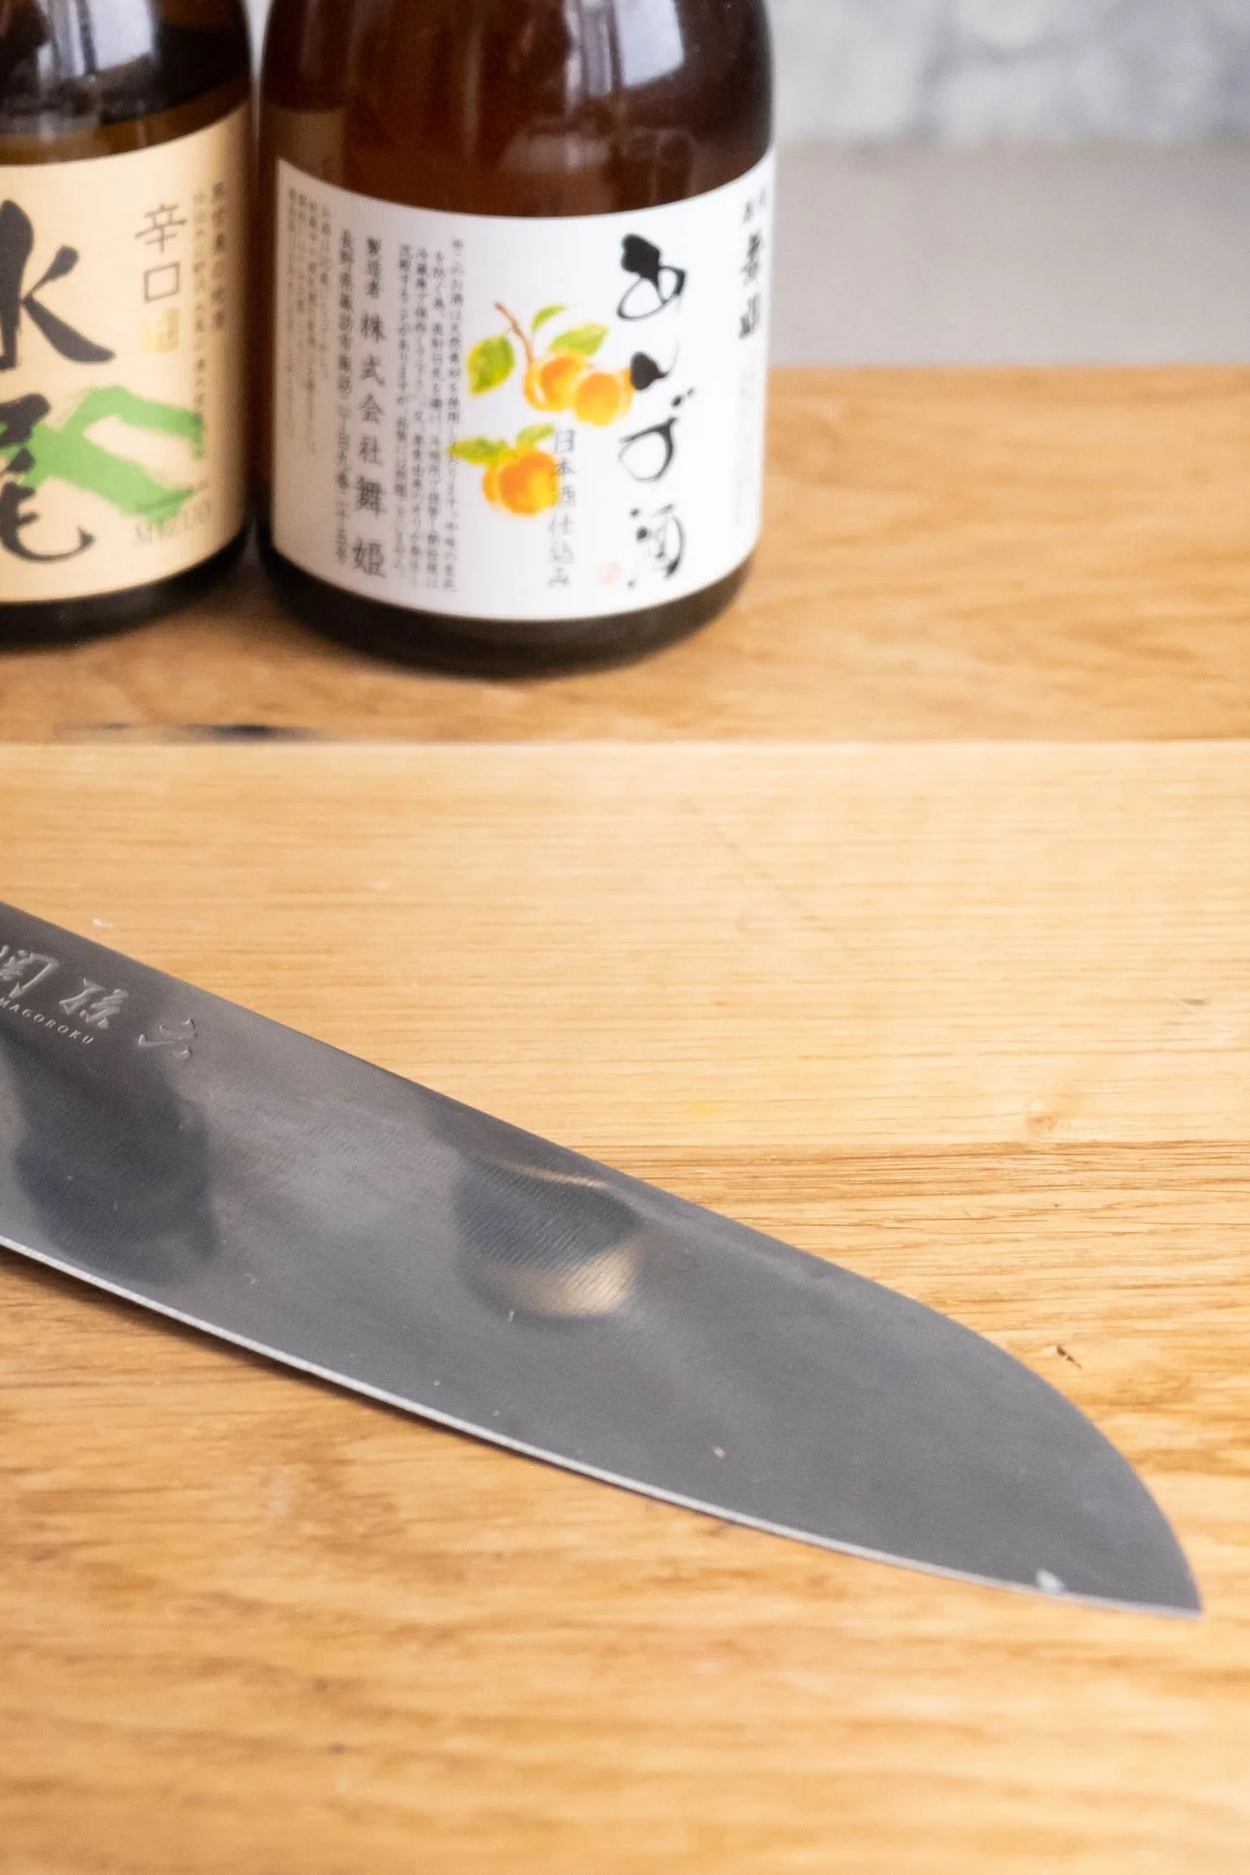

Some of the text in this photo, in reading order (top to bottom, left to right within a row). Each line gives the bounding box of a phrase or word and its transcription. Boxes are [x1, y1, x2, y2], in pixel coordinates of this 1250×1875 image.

[134, 203, 188, 304] 辛口
[351, 312, 388, 579] 株式会社舞姫
